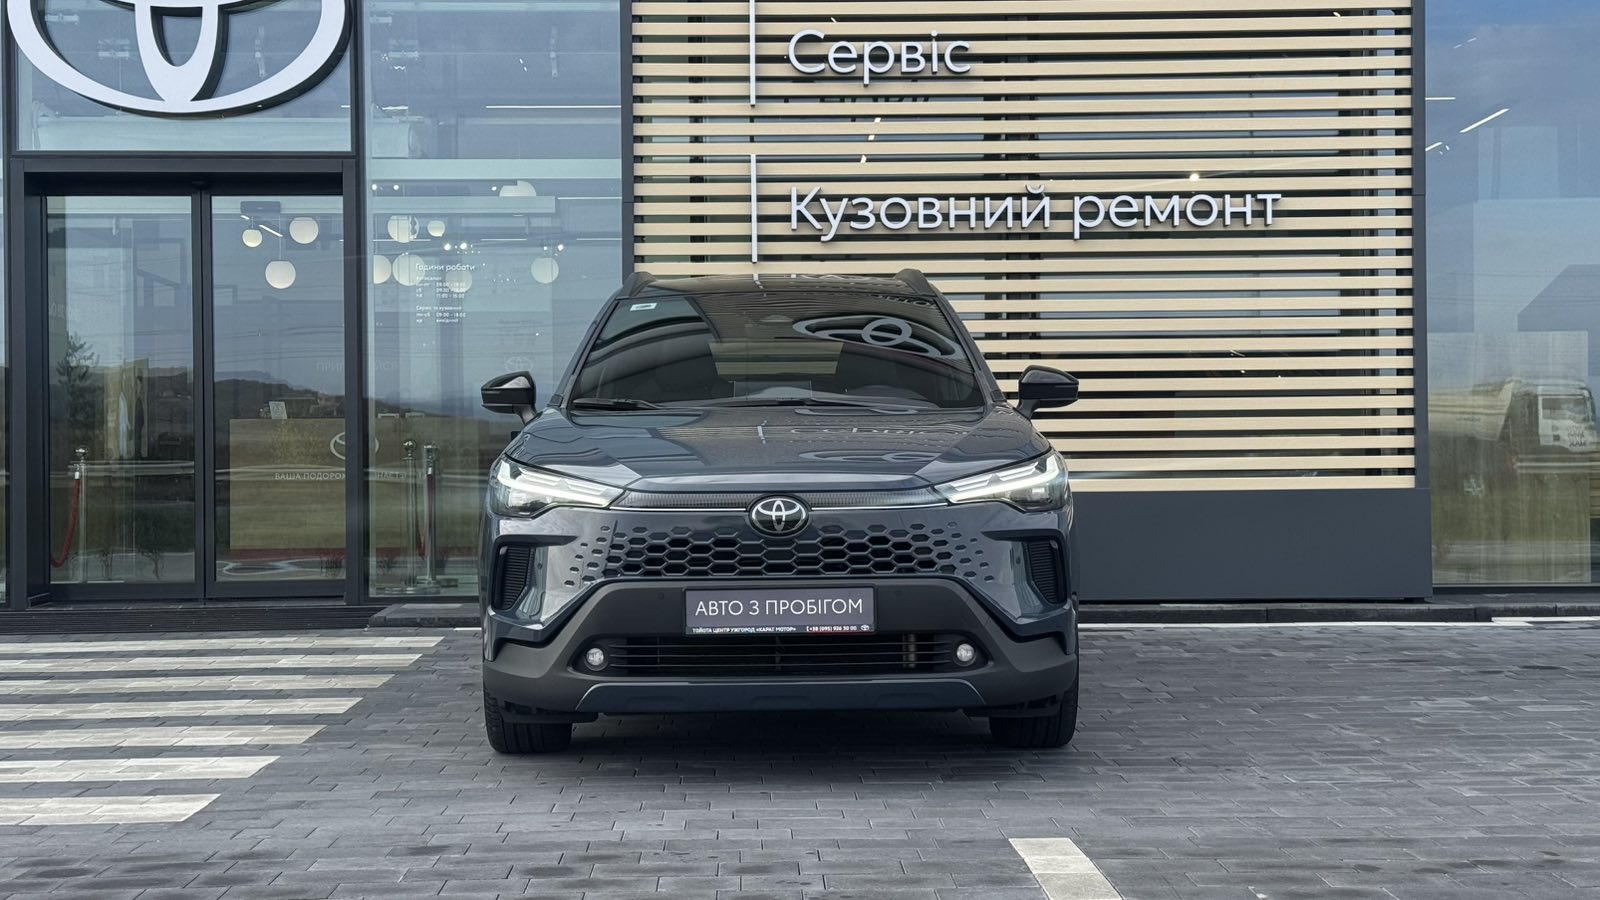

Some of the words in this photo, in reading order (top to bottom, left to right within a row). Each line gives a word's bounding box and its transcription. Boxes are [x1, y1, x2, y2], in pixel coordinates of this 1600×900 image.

[788, 29, 971, 87] Сервіс
[790, 184, 1051, 242] Кузовний
[1073, 191, 1282, 239] ремонт
[416, 263, 444, 271] Години
[445, 263, 475, 272] роботи
[695, 600, 744, 616] АВТО
[748, 600, 760, 615] З
[765, 599, 863, 615] ПРОБІГОМ
